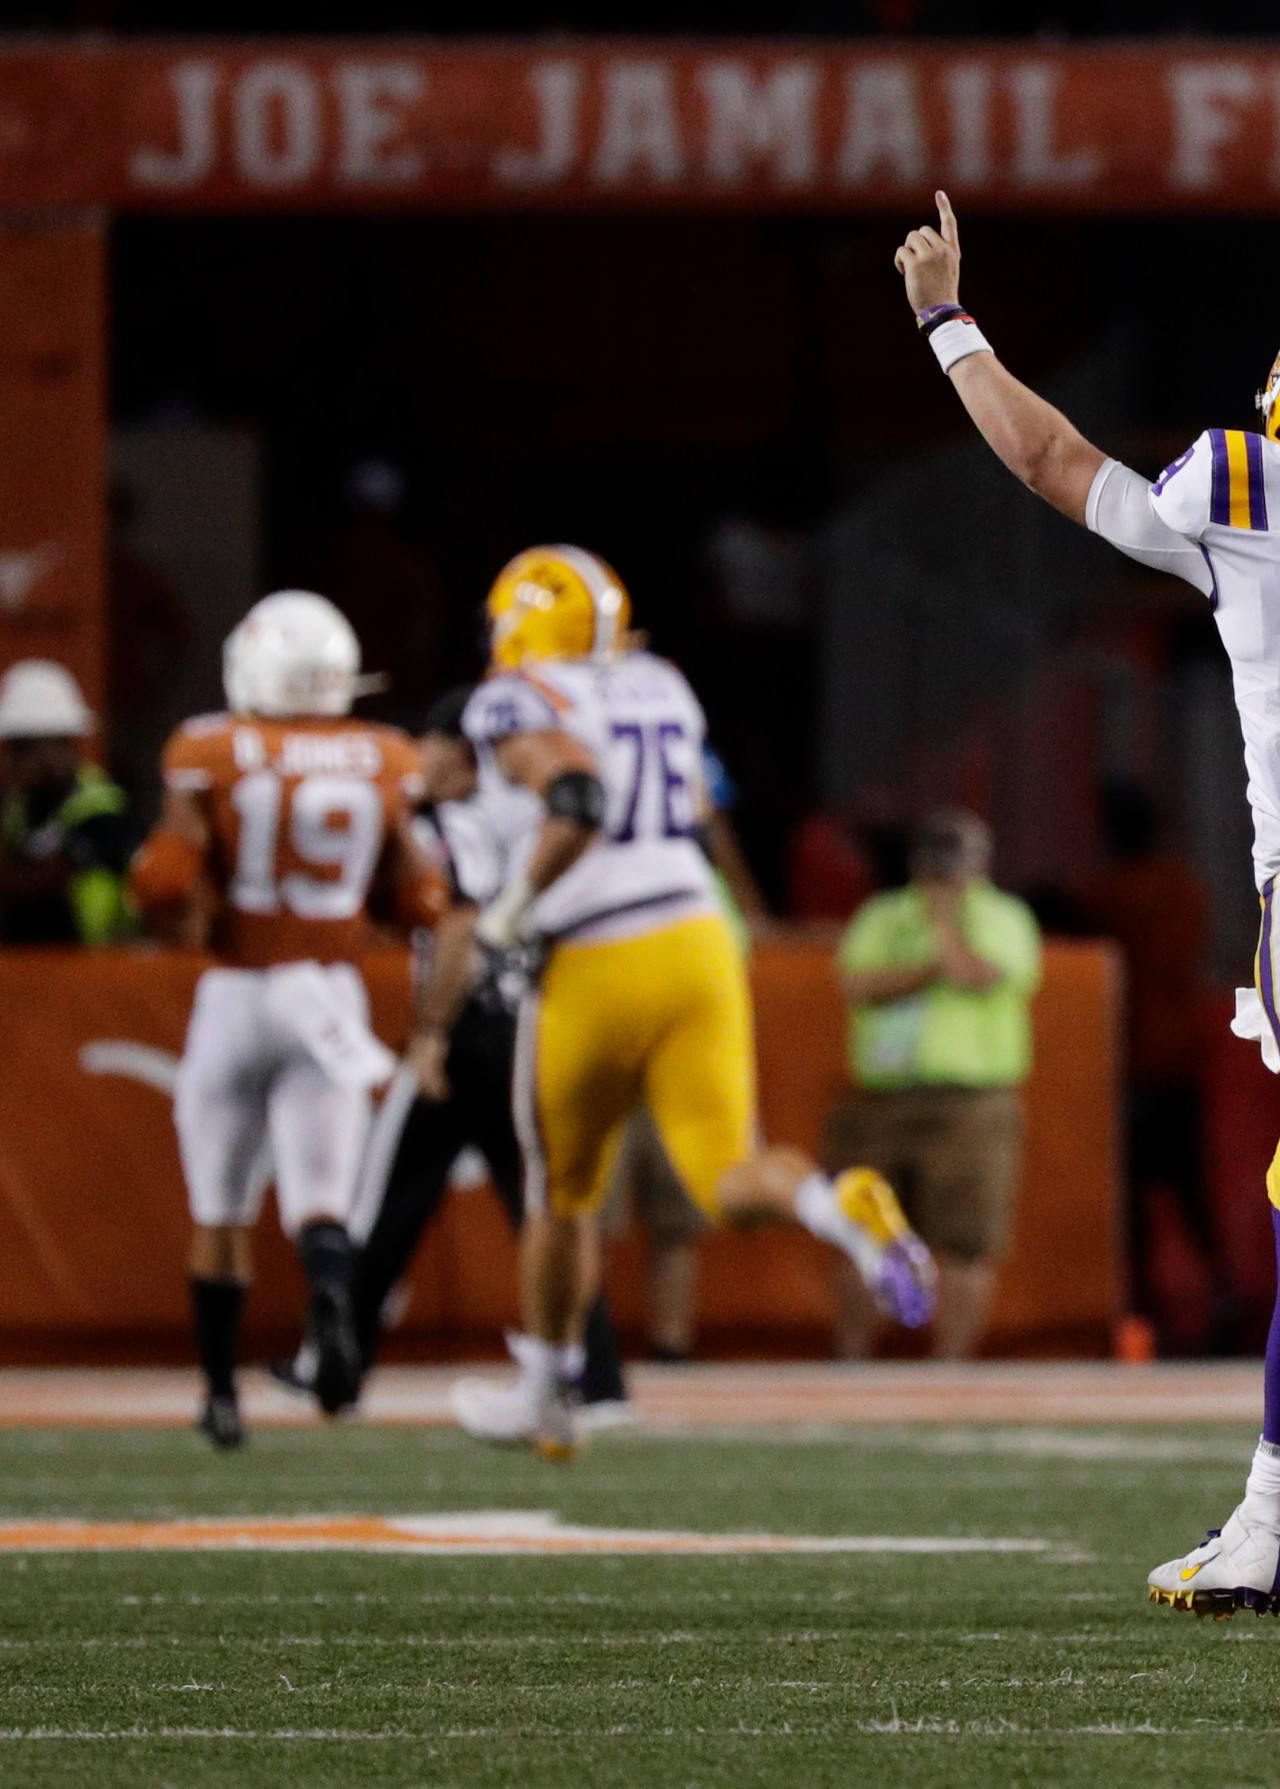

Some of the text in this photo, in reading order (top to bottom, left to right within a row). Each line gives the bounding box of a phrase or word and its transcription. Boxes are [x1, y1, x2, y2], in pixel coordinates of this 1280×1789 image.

[130, 62, 426, 186] JOE
[490, 60, 1097, 186] JAMAIL
[229, 768, 385, 920] 19
[611, 720, 700, 842] 76
